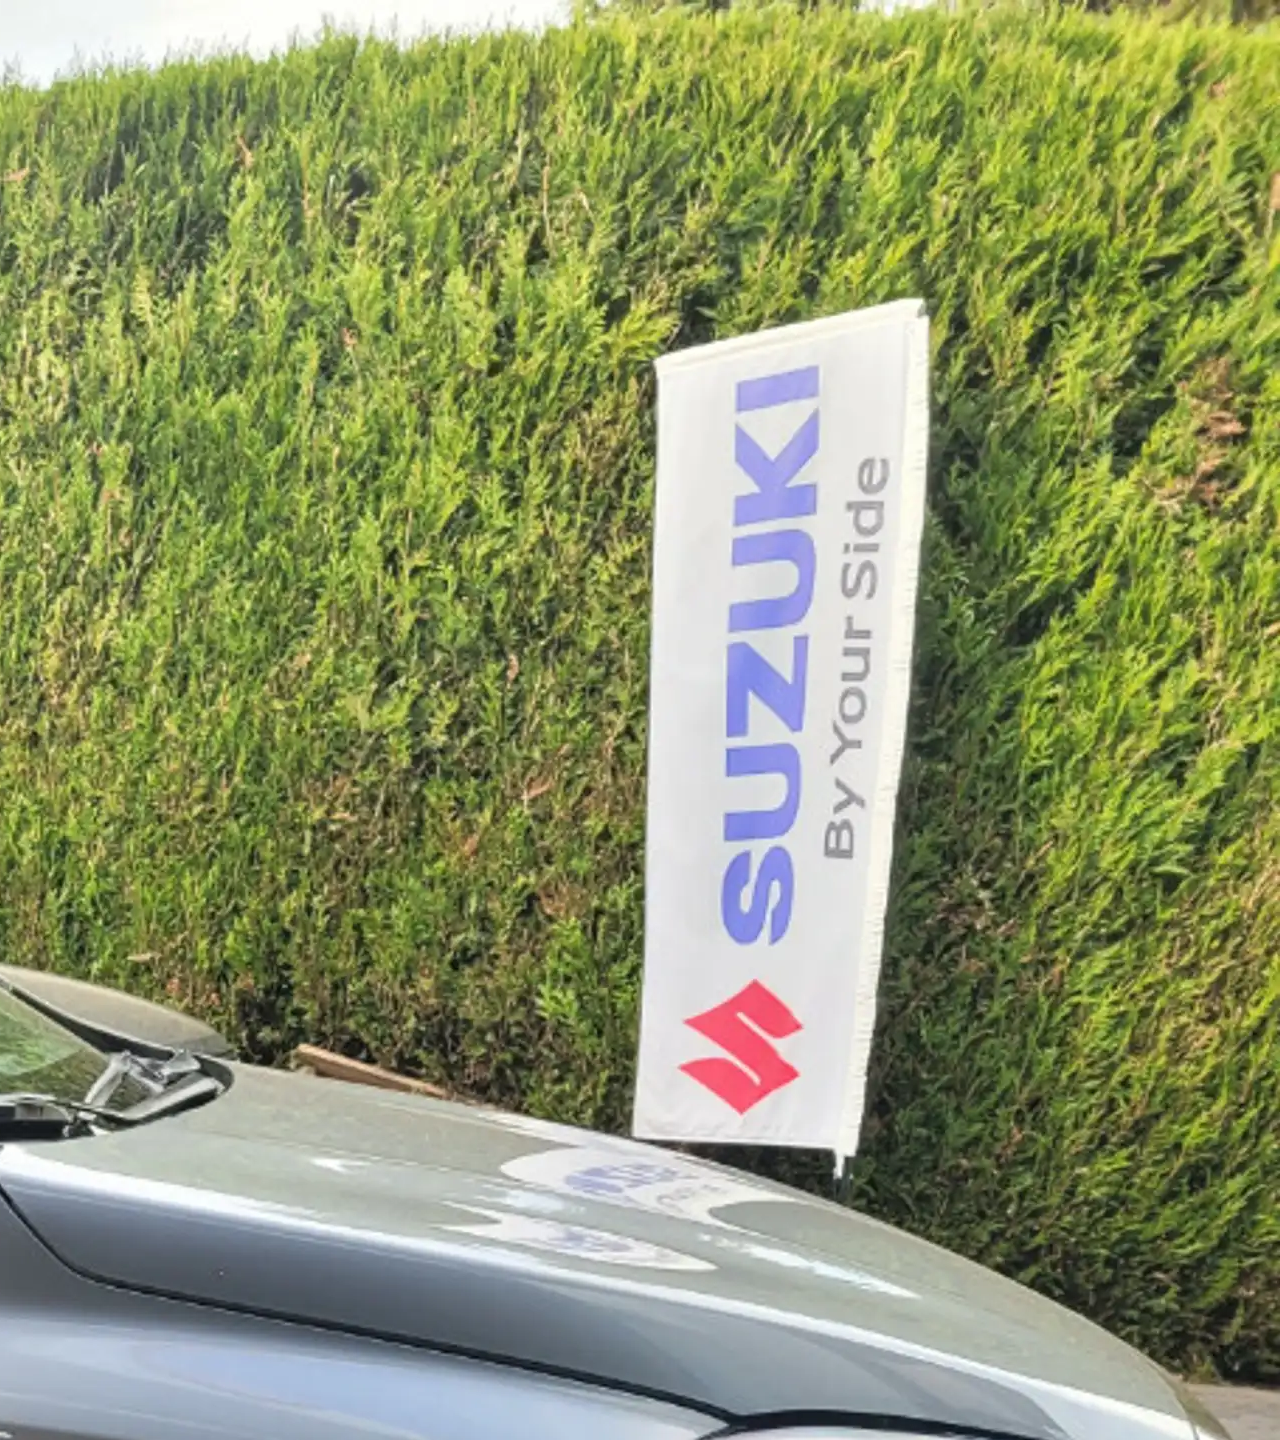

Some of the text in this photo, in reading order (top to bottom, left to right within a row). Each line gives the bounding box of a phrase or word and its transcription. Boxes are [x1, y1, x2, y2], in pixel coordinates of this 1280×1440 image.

[721, 366, 820, 946] SUZUKI
[823, 457, 890, 861] By Your Side
